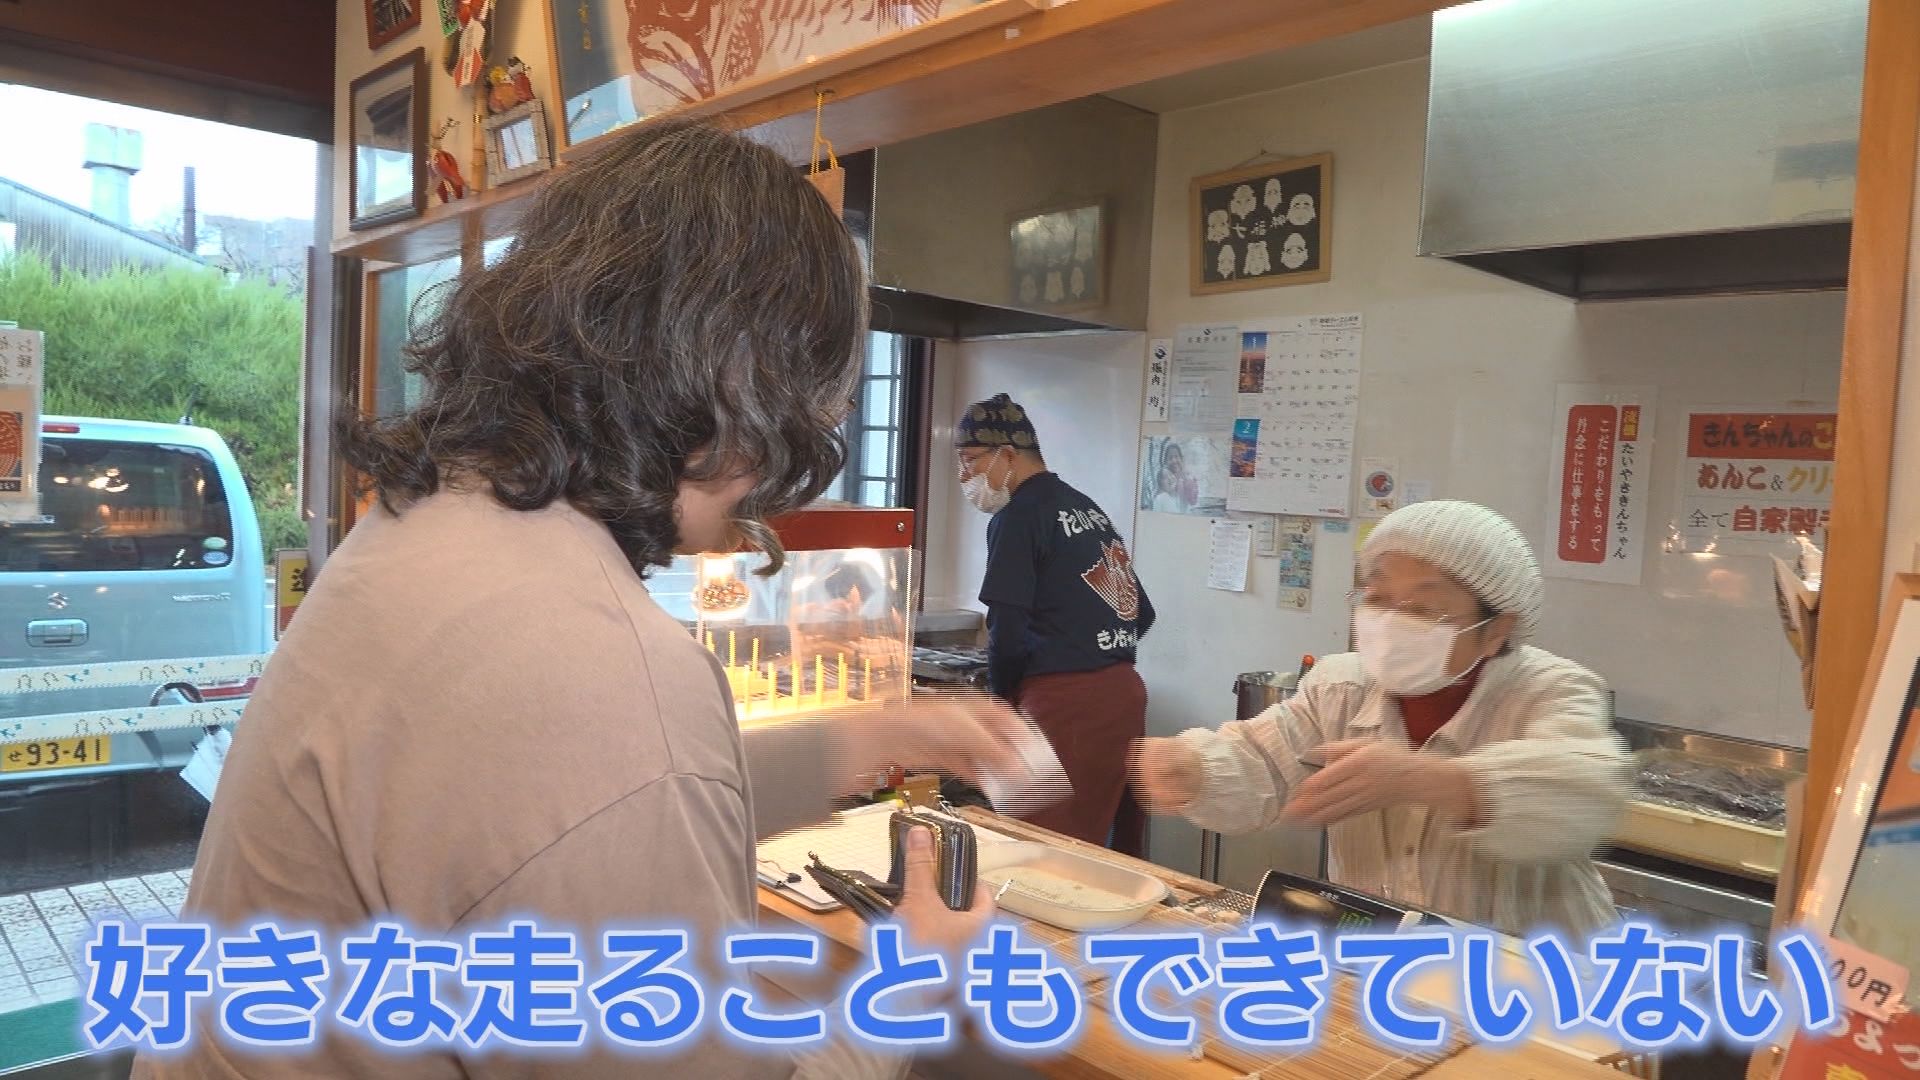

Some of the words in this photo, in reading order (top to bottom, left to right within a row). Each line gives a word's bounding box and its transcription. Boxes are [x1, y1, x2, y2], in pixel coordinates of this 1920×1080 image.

[1590, 420, 1609, 552] こだわりをもって
[1096, 627, 1138, 651] きんちゃ
[8, 751, 21, 762] せ
[26, 738, 101, 766] 93-41
